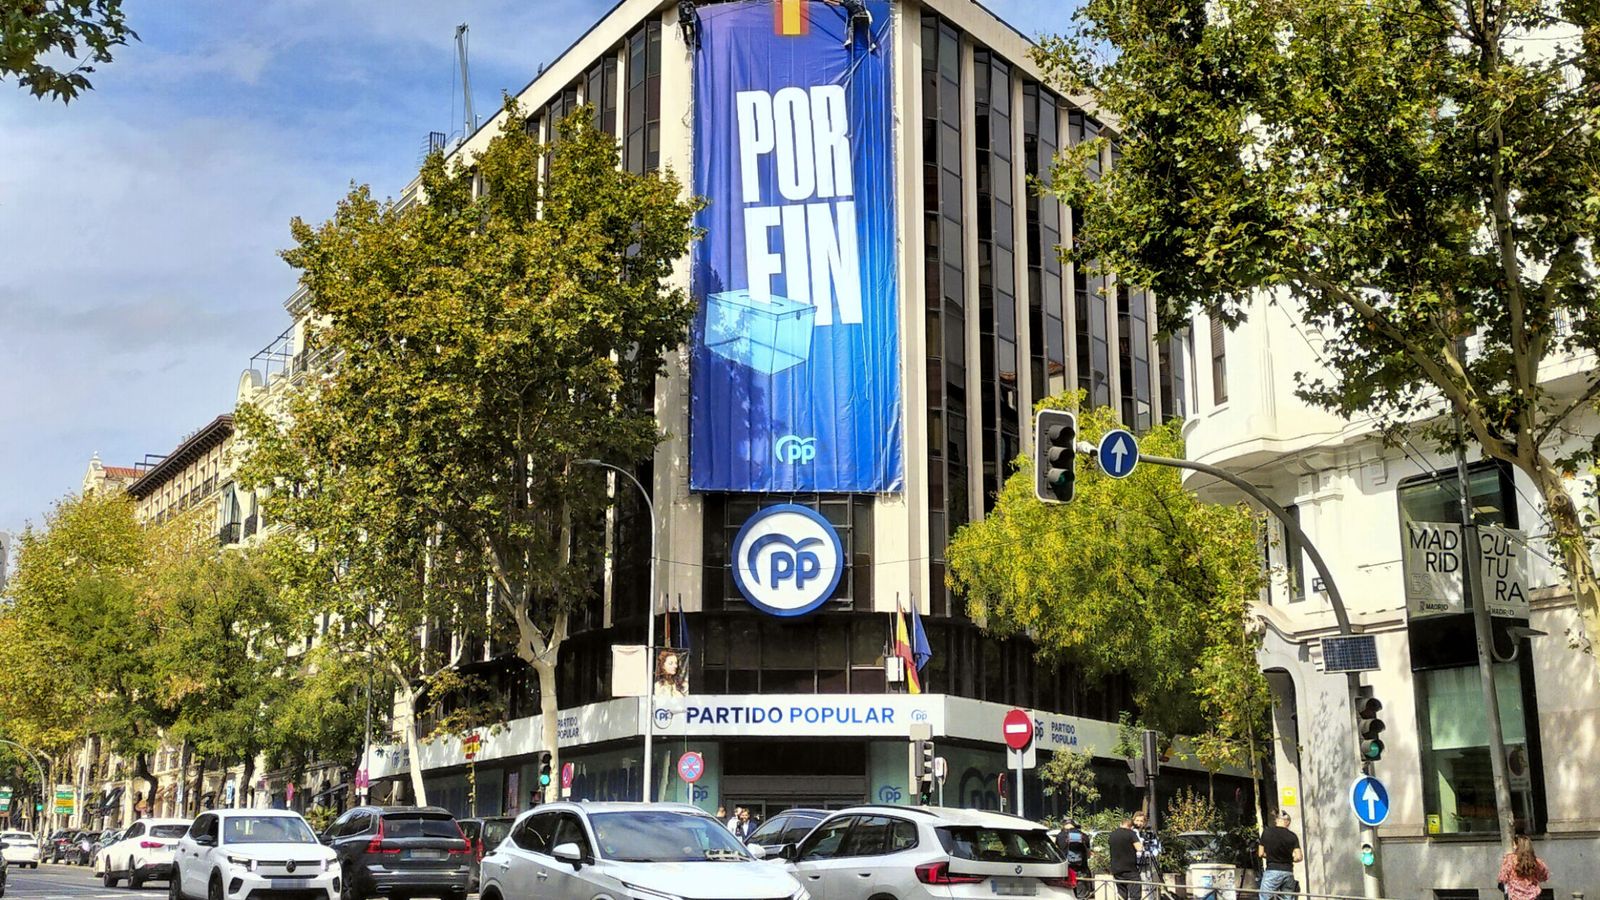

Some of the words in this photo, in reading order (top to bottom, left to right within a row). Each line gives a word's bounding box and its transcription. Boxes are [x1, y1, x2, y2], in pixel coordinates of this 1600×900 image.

[736, 84, 853, 203] POR
[743, 201, 863, 327] FIN
[1410, 530, 1459, 551] MAD
[1481, 534, 1516, 557] CUL
[1426, 552, 1459, 573] RID
[1485, 556, 1509, 579] TU
[1495, 580, 1526, 602] RA
[686, 707, 783, 724] PARTIDO
[790, 707, 895, 724] POPULAR
[1051, 722, 1076, 734] PARTIDO
[1051, 733, 1078, 746] POPULAR
